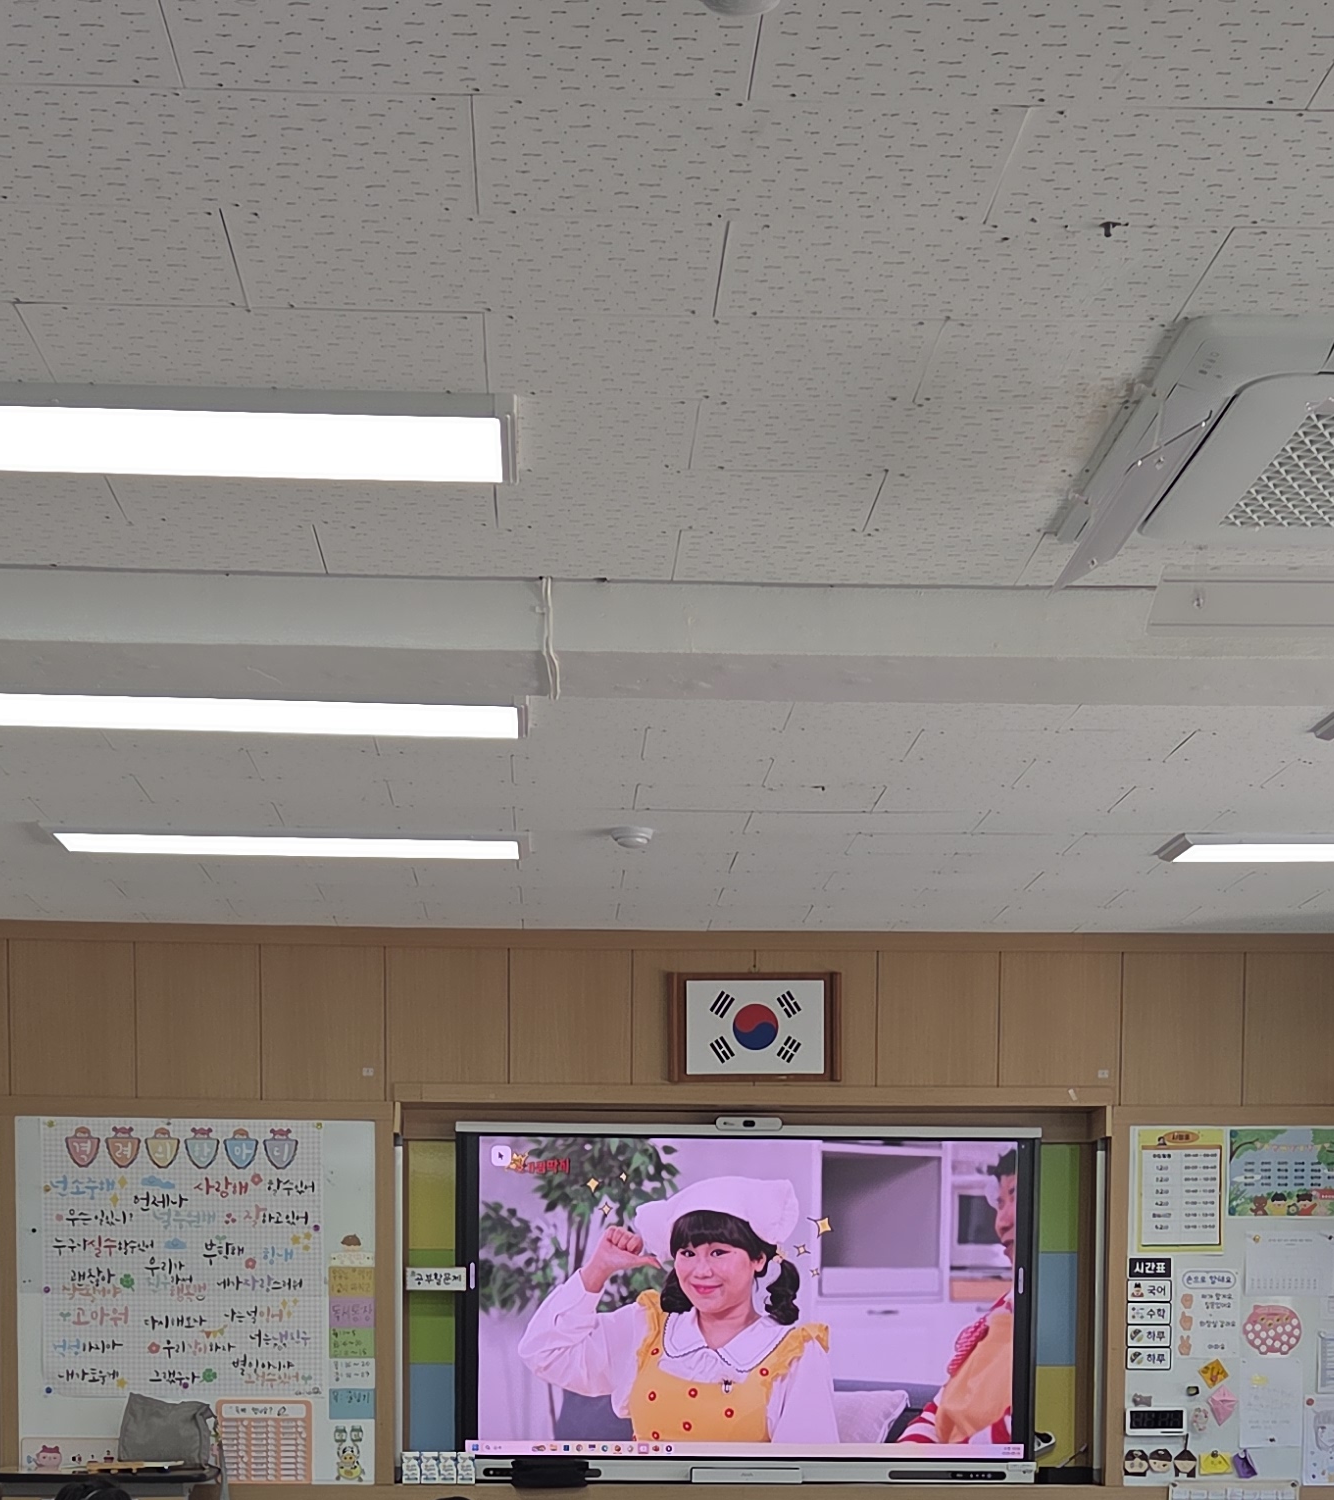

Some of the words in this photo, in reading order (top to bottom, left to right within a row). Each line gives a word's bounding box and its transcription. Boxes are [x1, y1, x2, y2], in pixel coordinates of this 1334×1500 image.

[193, 1176, 249, 1198] 사랑해
[133, 1191, 189, 1212] 언제나
[1133, 1261, 1166, 1274] 시간표
[1147, 1284, 1166, 1297] 국어
[1146, 1308, 1166, 1320] 수학
